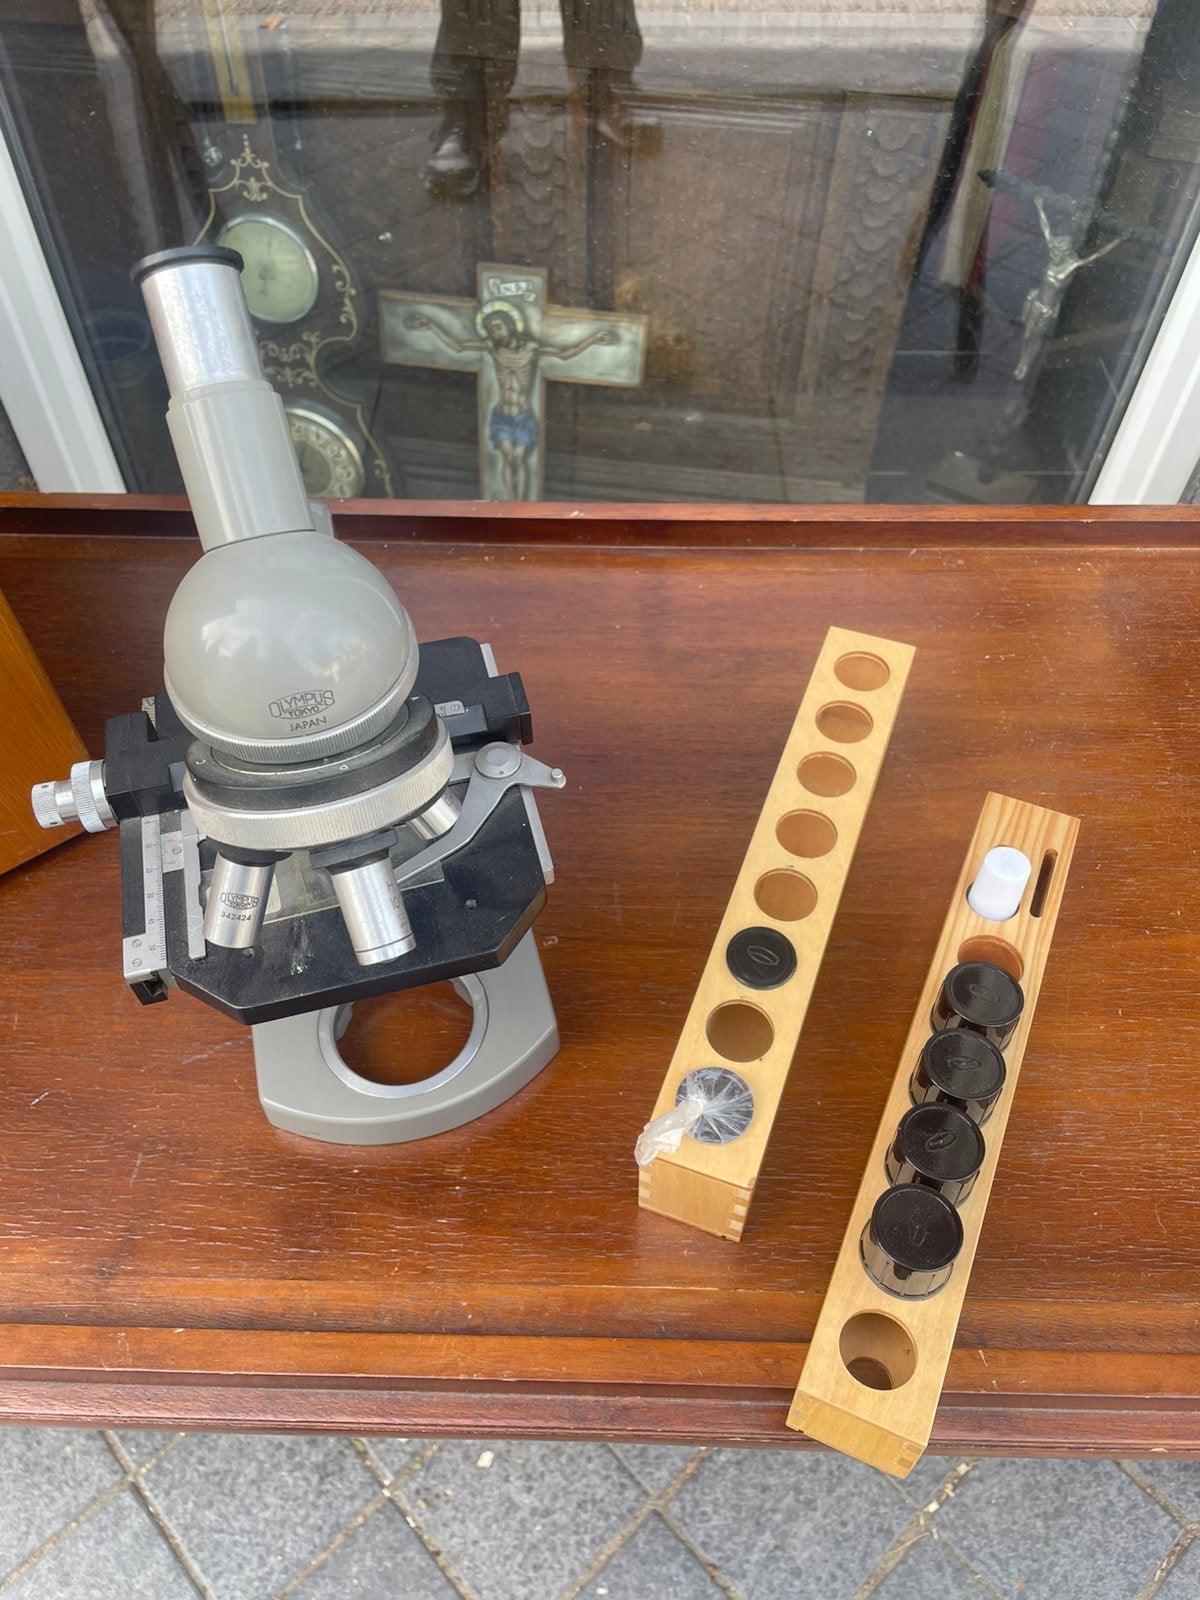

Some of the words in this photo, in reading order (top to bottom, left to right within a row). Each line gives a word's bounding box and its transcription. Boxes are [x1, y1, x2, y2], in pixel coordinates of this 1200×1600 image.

[268, 689, 336, 718] OLYMPUS
[288, 705, 320, 718] TOKYO
[290, 716, 327, 732] JAPAN
[220, 911, 252, 922] 342424
